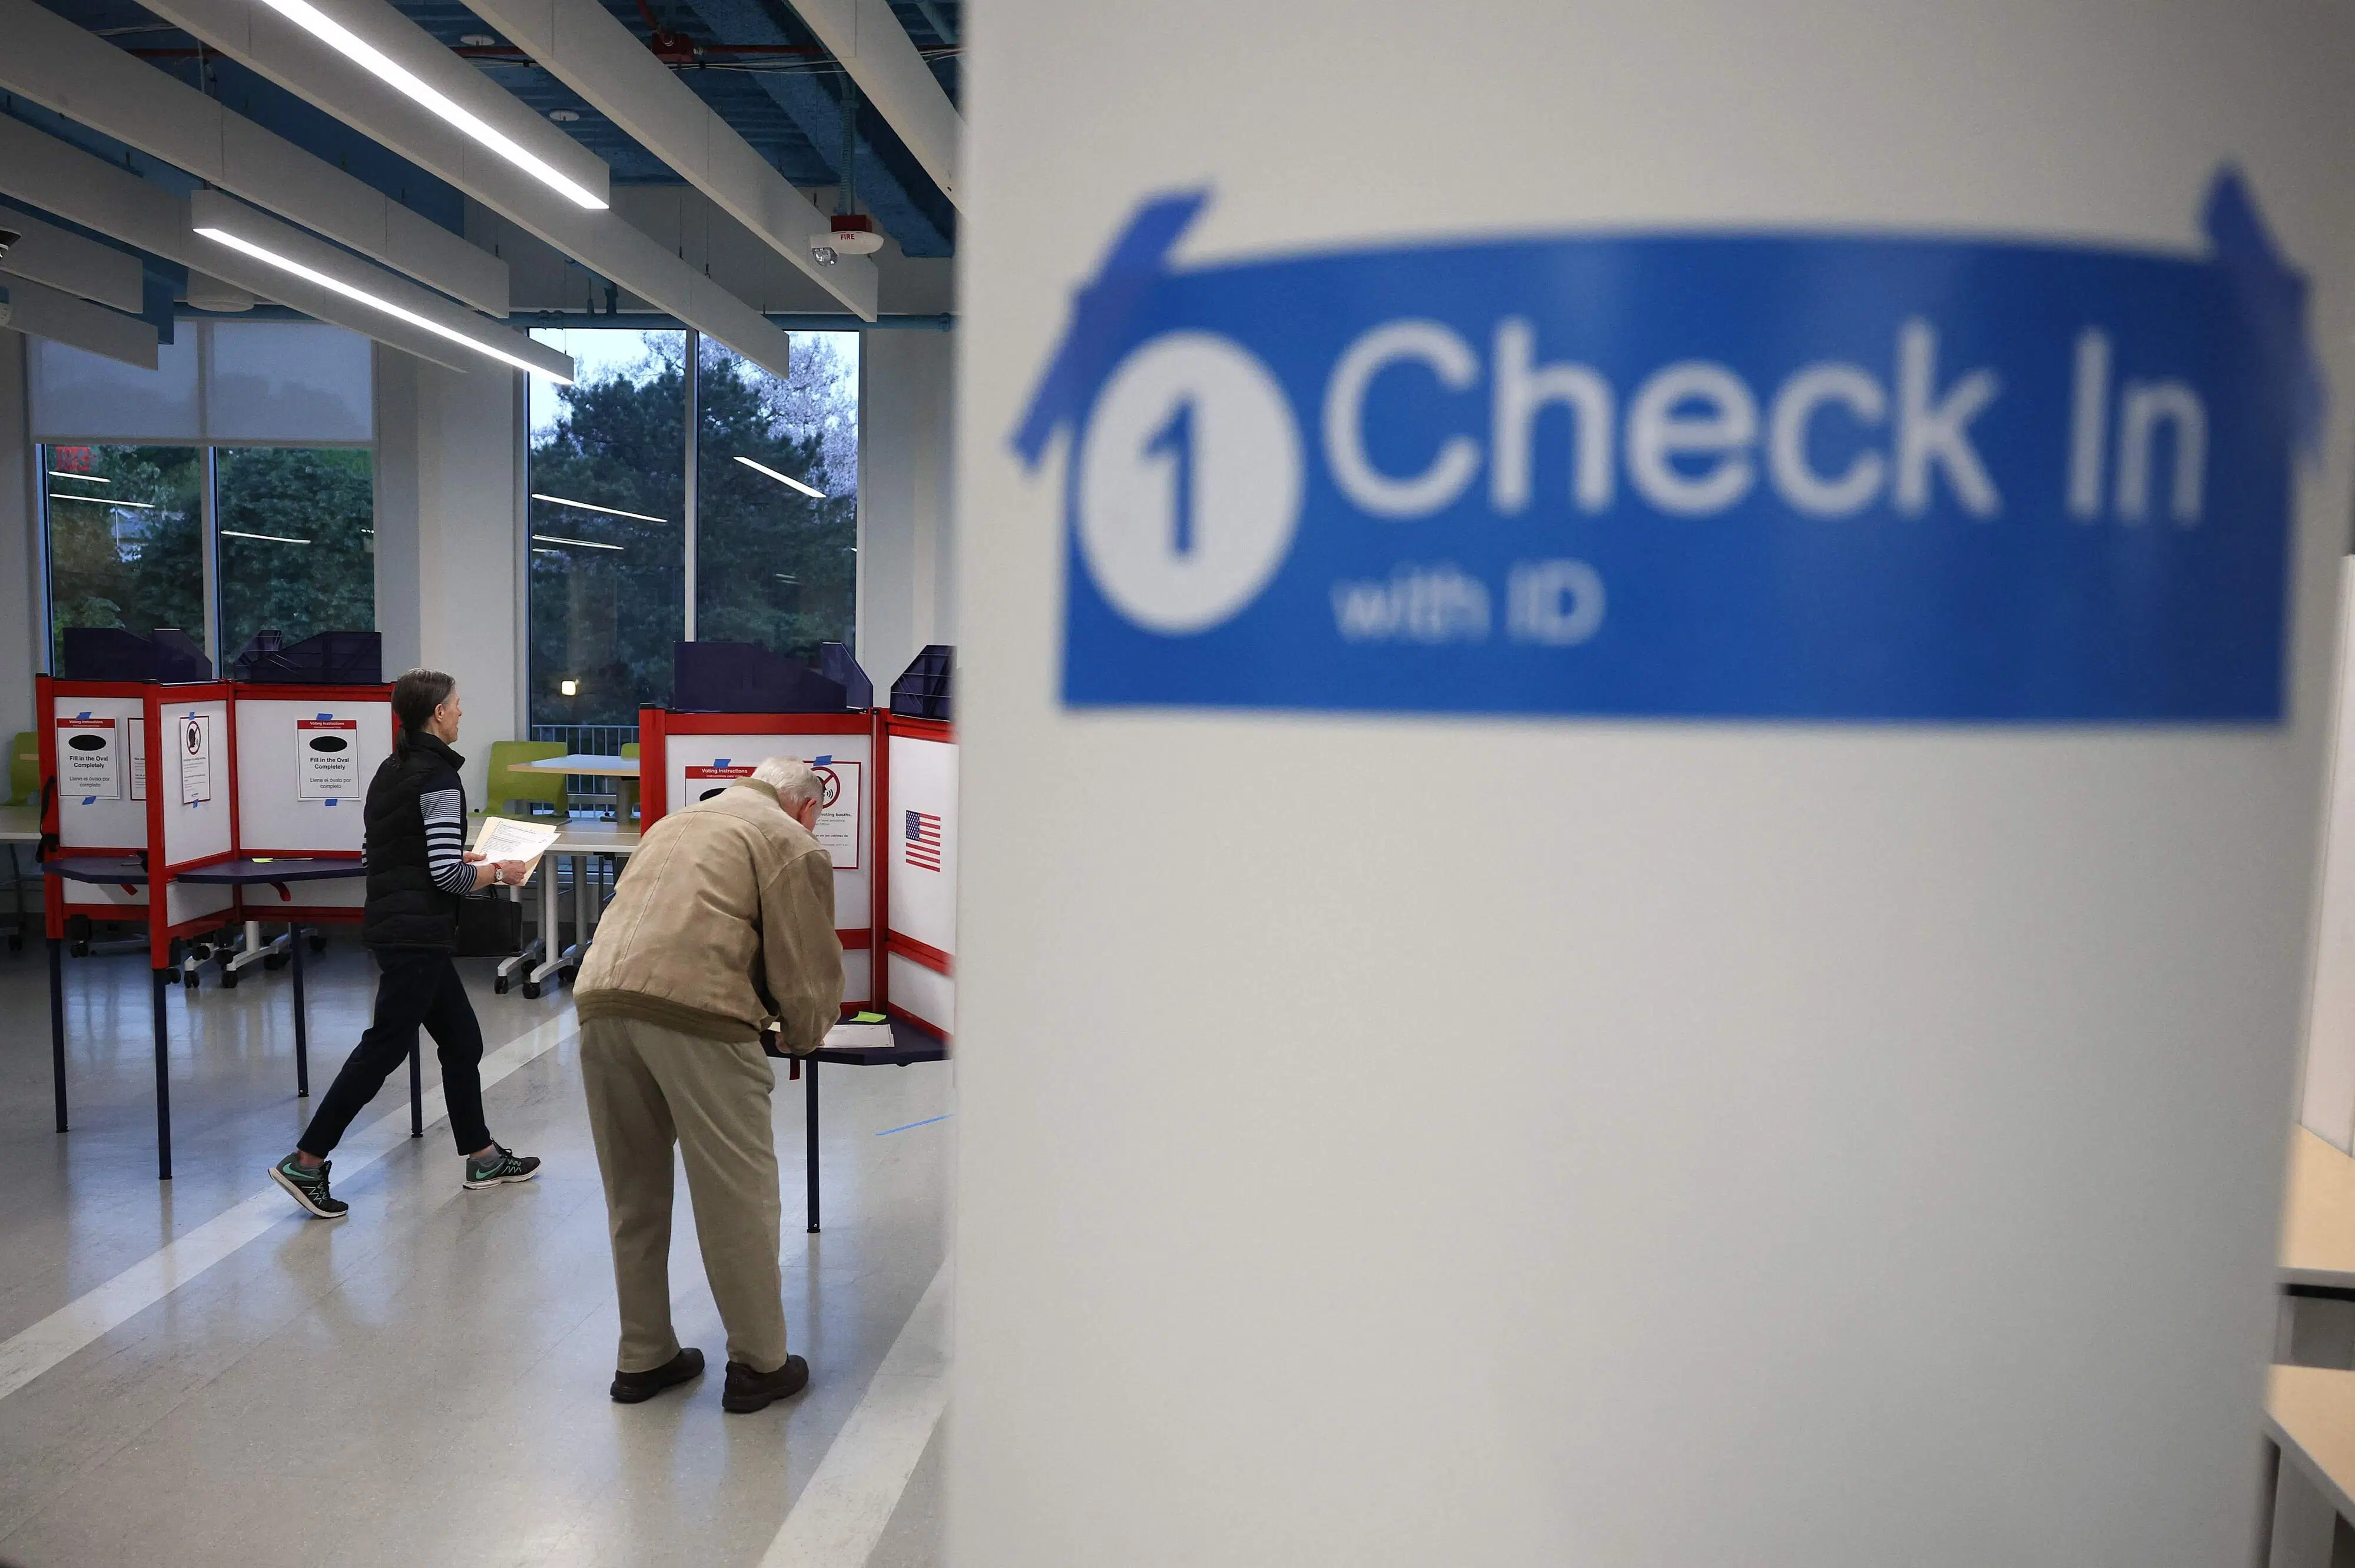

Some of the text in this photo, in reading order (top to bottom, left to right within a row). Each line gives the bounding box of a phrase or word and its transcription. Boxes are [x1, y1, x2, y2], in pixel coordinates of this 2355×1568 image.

[1141, 390, 1198, 559] 1
[1324, 315, 2208, 520] Check In
[1331, 559, 1606, 645] with ID
